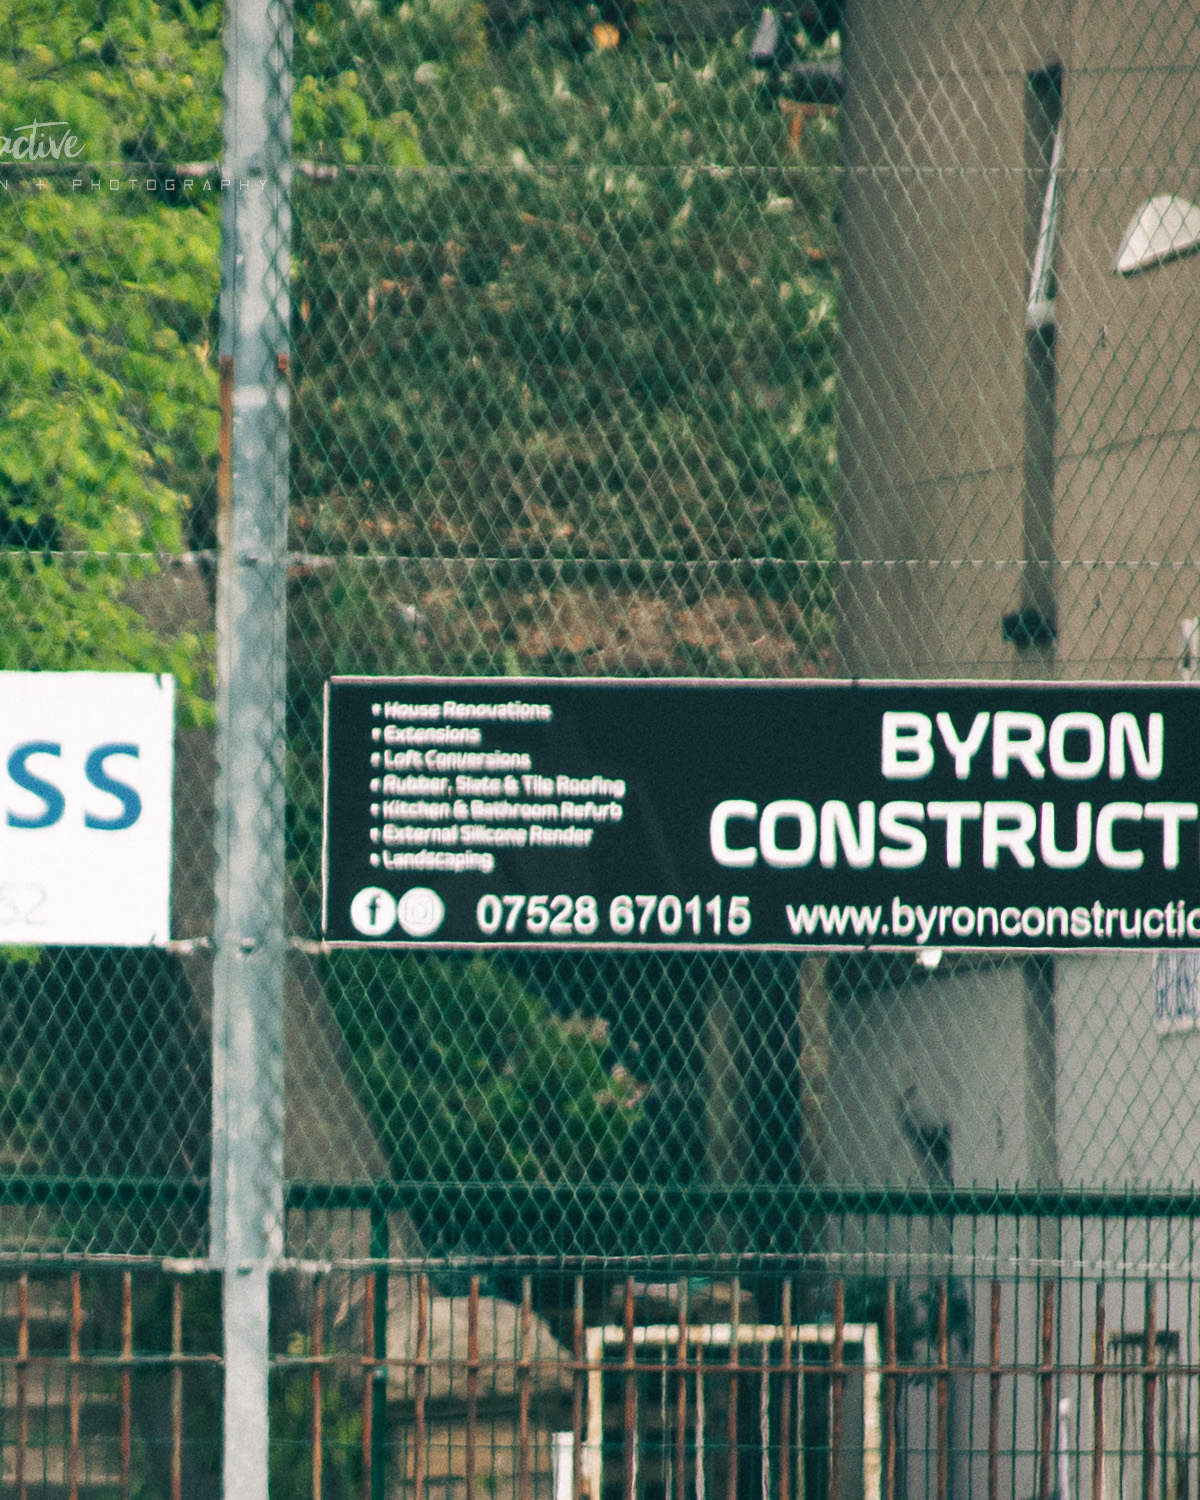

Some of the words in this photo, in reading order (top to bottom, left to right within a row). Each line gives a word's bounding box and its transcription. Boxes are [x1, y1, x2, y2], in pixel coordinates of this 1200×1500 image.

[384, 701, 441, 720] House
[443, 700, 553, 721] Renovations
[384, 724, 482, 745] Extensions
[881, 711, 1164, 780] BYRON
[384, 749, 424, 771] Loft
[425, 749, 532, 771] Conversions
[521, 774, 554, 796] Tile
[556, 775, 626, 798] Roofing
[383, 799, 451, 819] Kitchen
[470, 799, 559, 821] Bathroom
[561, 801, 623, 822] Refurb
[383, 823, 459, 846] External
[529, 825, 594, 848] Render
[382, 849, 496, 874] Landscaping
[476, 894, 599, 935] 07528
[610, 894, 752, 936] 670115
